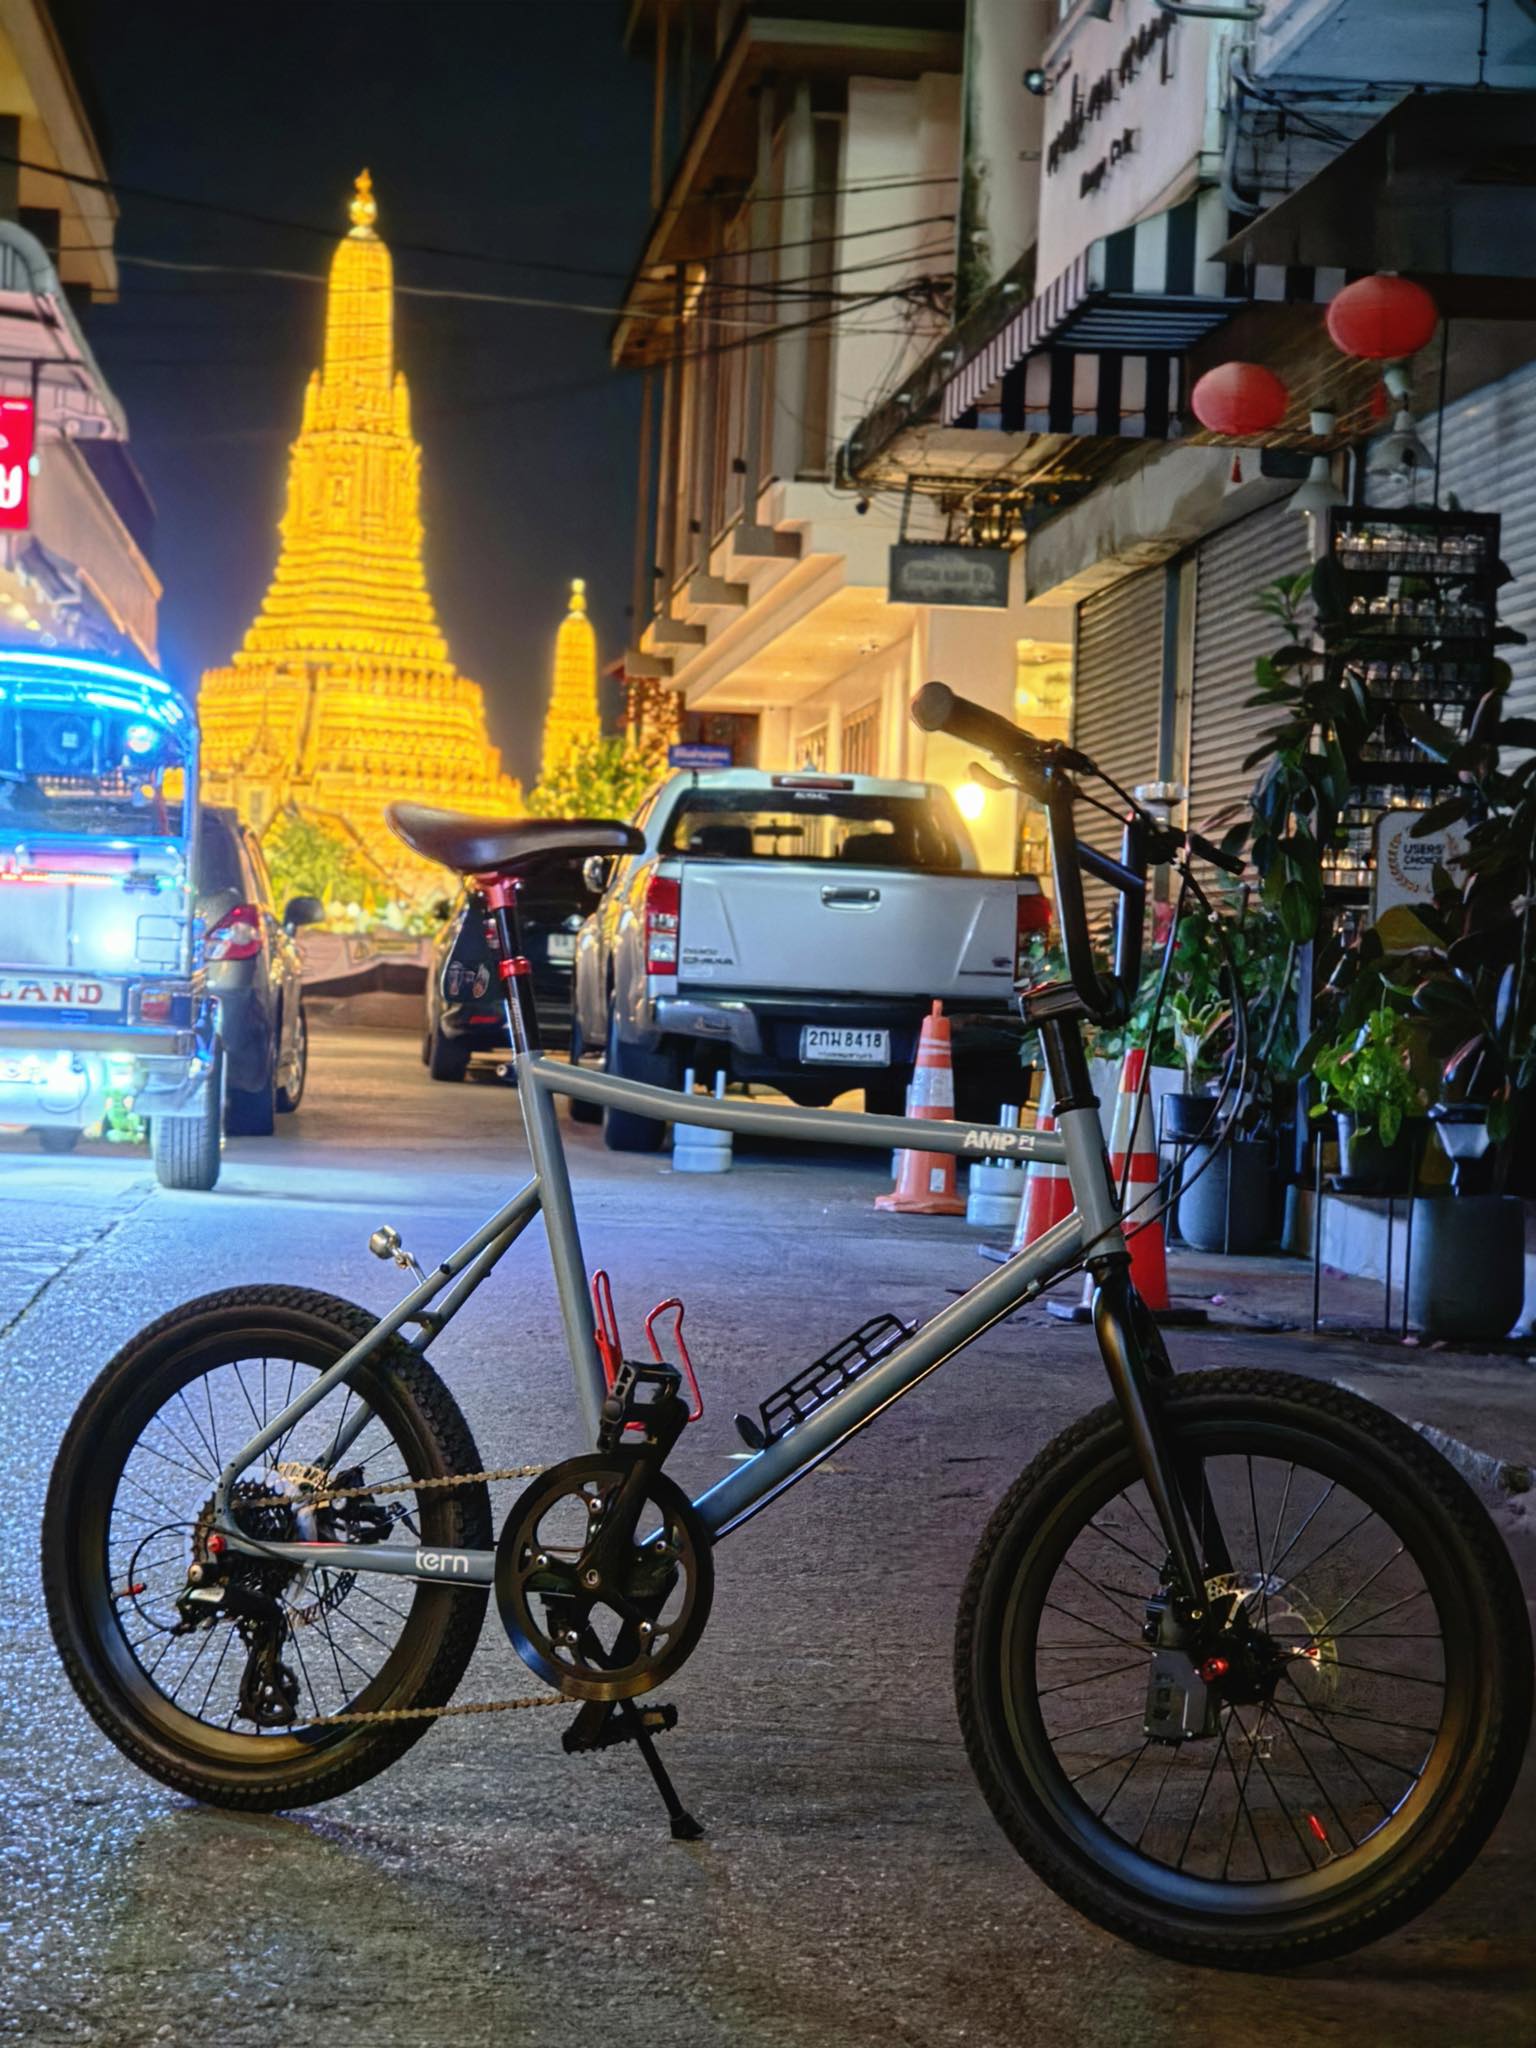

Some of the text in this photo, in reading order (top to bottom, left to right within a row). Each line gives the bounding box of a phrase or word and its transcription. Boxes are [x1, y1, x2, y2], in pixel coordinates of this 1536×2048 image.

[844, 1031, 882, 1049] 8418
[963, 1130, 1017, 1151] AMP
[415, 1549, 469, 1574] tern
